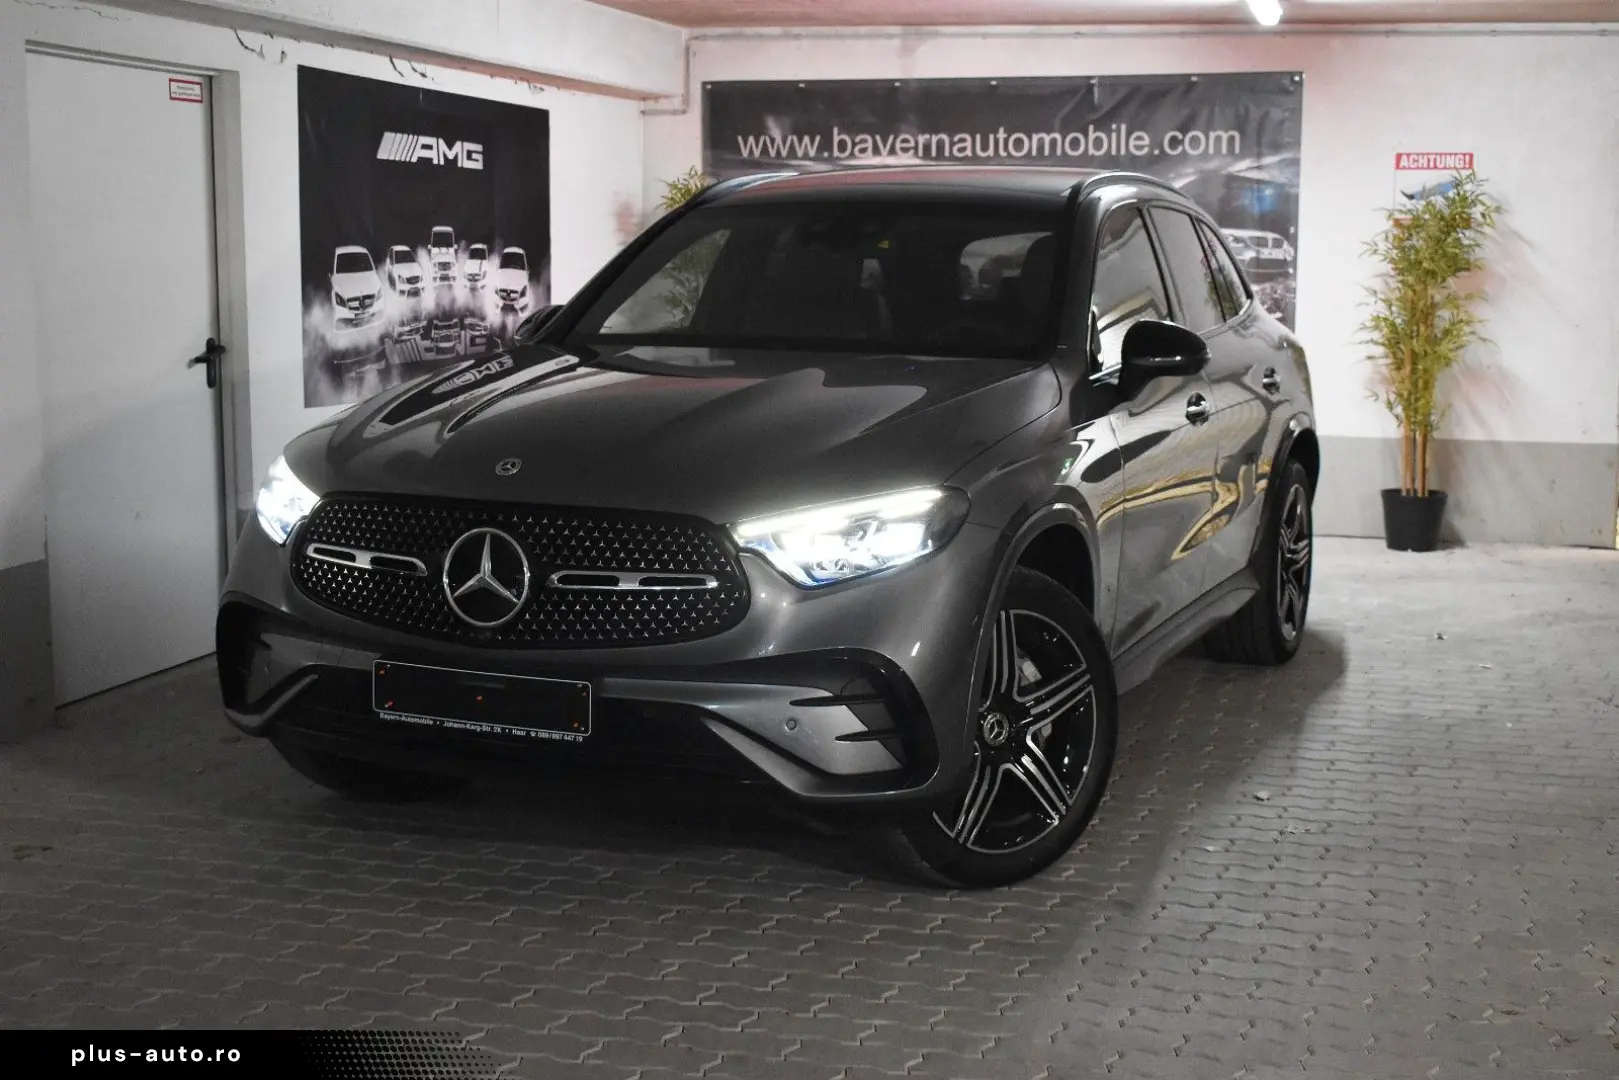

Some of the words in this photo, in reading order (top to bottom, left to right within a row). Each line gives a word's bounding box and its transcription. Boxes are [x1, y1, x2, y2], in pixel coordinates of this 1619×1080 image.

[411, 135, 483, 170] AMG
[1399, 154, 1470, 169] ACHTUNG!
[380, 712, 434, 725] Bayern-Automobile
[443, 720, 492, 732] Johann-Karg-Str.
[512, 728, 527, 736] Haar
